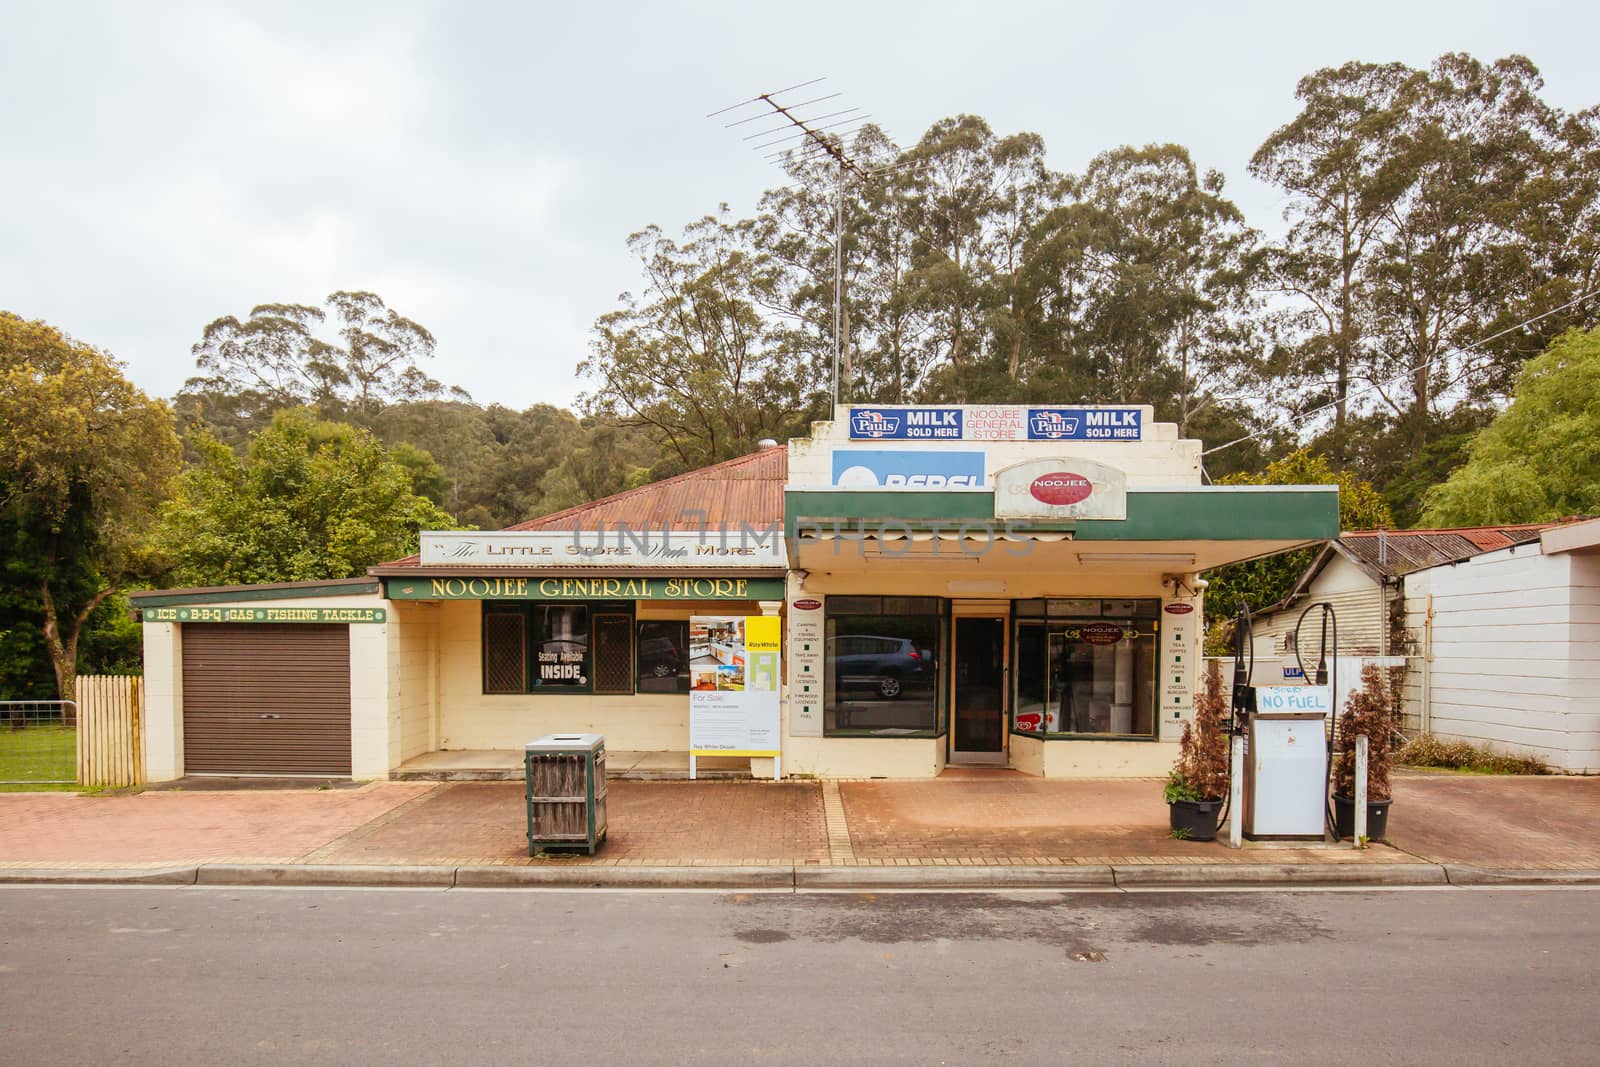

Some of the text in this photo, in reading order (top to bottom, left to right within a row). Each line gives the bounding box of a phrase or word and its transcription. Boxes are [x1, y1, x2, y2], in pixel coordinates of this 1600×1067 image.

[907, 411, 957, 426] MILK
[969, 409, 1021, 419] NOOJEE
[1086, 412, 1138, 426] MILK
[859, 419, 894, 432] Pauls
[966, 419, 1024, 429] GENERAL
[1037, 420, 1073, 432] Pauls
[907, 428, 959, 437] SOLD HERE
[974, 429, 1016, 439] STORE
[1086, 428, 1139, 438] SOLD HERE
[1033, 479, 1088, 488] NOOJEE
[431, 578, 747, 597] NOOJEE GENERAL STORE
[157, 609, 177, 620] ICE
[229, 609, 254, 620] GAS
[267, 609, 318, 620] FISHING
[322, 610, 374, 621] TACKLE
[540, 664, 581, 679] INSIDE
[693, 694, 706, 702] For
[1262, 695, 1327, 709] NO FUEL
